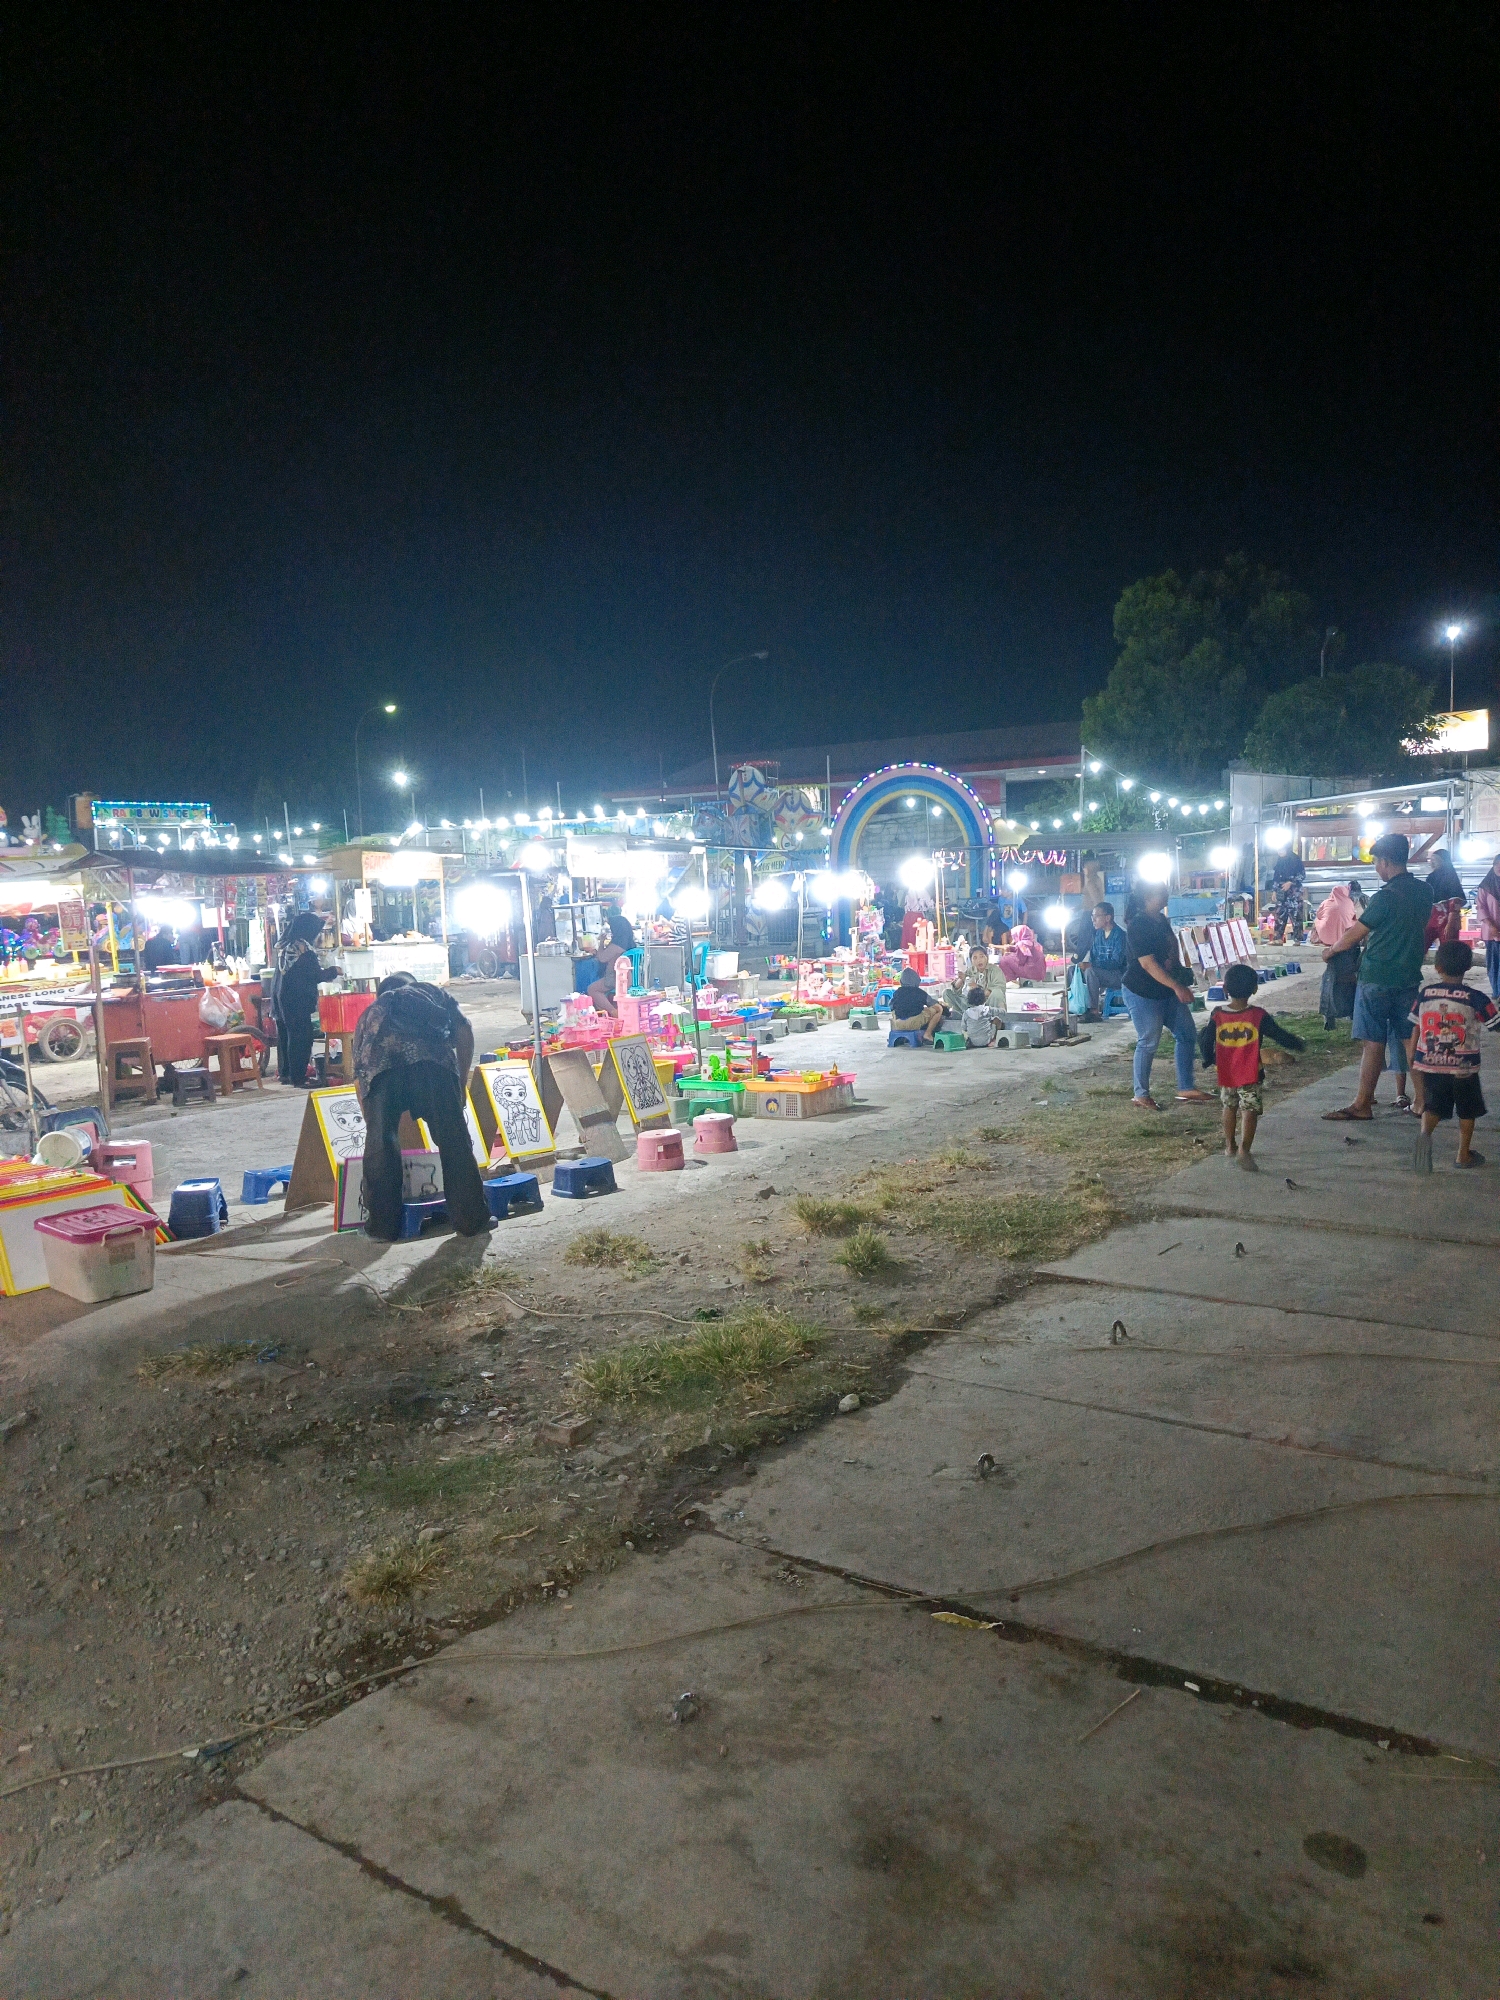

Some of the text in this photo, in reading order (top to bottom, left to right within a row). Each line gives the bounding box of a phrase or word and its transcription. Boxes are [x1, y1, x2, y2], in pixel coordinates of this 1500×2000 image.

[112, 808, 189, 818] RAINBOW SLIDE
[0, 993, 31, 1001] NESE
[35, 989, 65, 997] LONG
[1424, 988, 1471, 1000] ROBLOX
